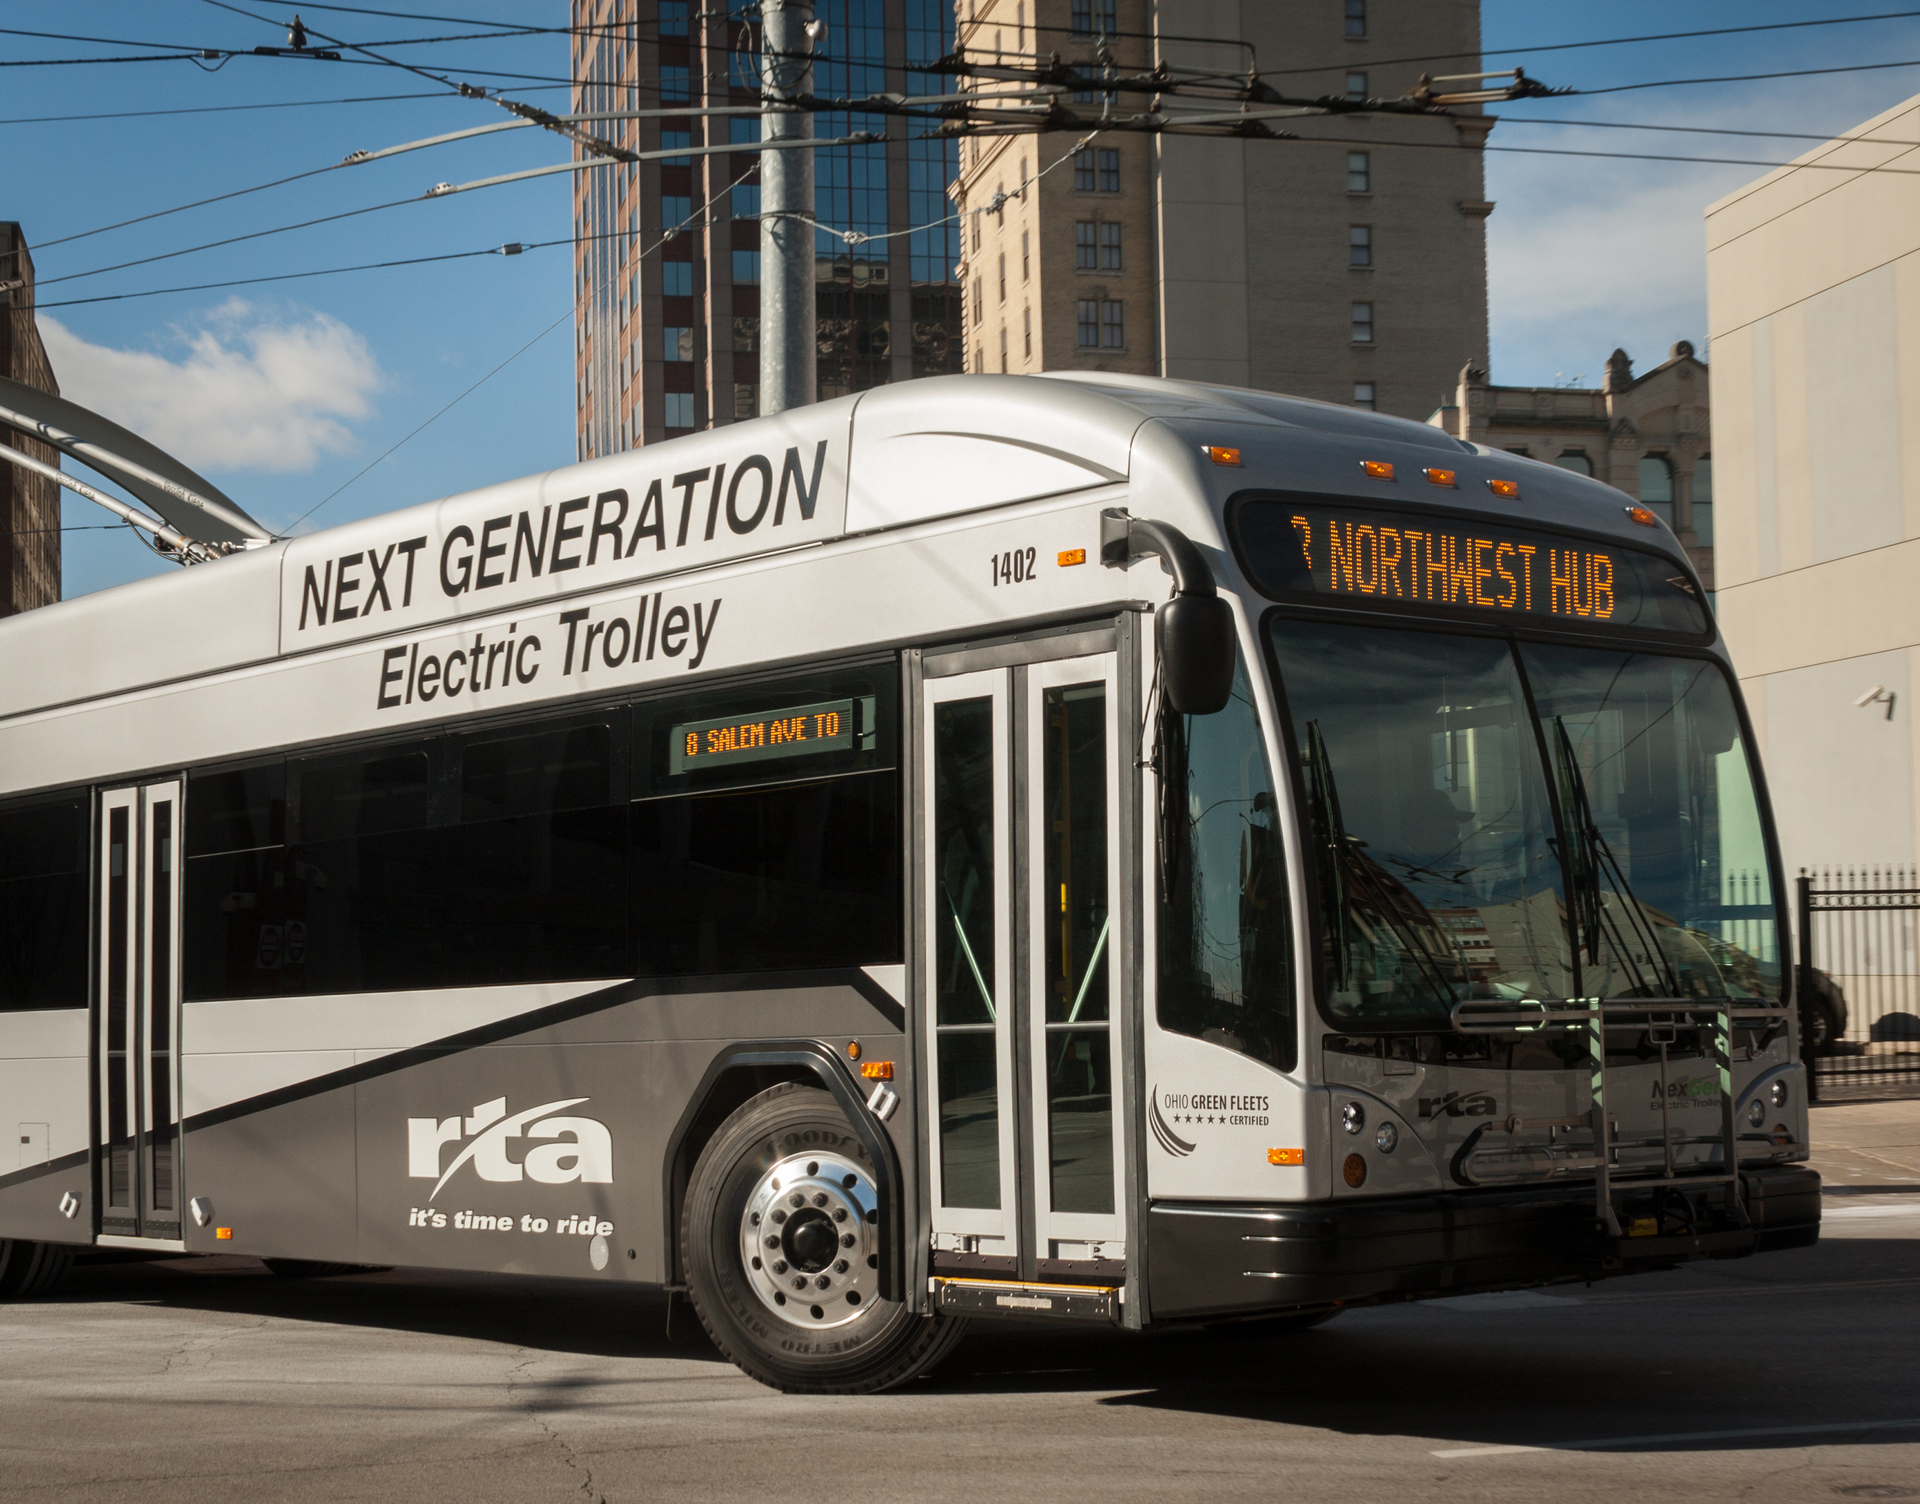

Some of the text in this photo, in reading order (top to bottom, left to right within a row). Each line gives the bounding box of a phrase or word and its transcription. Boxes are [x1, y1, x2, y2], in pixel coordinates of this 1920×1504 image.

[298, 439, 828, 631] NEXT GENERATION
[991, 546, 1036, 587] 1402
[1331, 520, 1536, 611] NORTHWEST
[1550, 549, 1614, 618] HUB
[376, 592, 722, 710] Electric Trolley
[686, 712, 839, 756] 8 SALEM AVE TO
[1164, 1094, 1269, 1111] OHIO GREEN FLEETS
[1229, 1115, 1269, 1126] CERTIFIED
[1418, 1090, 1497, 1125] rta
[407, 1095, 613, 1203] rta
[409, 1207, 614, 1237] it's time to ride
